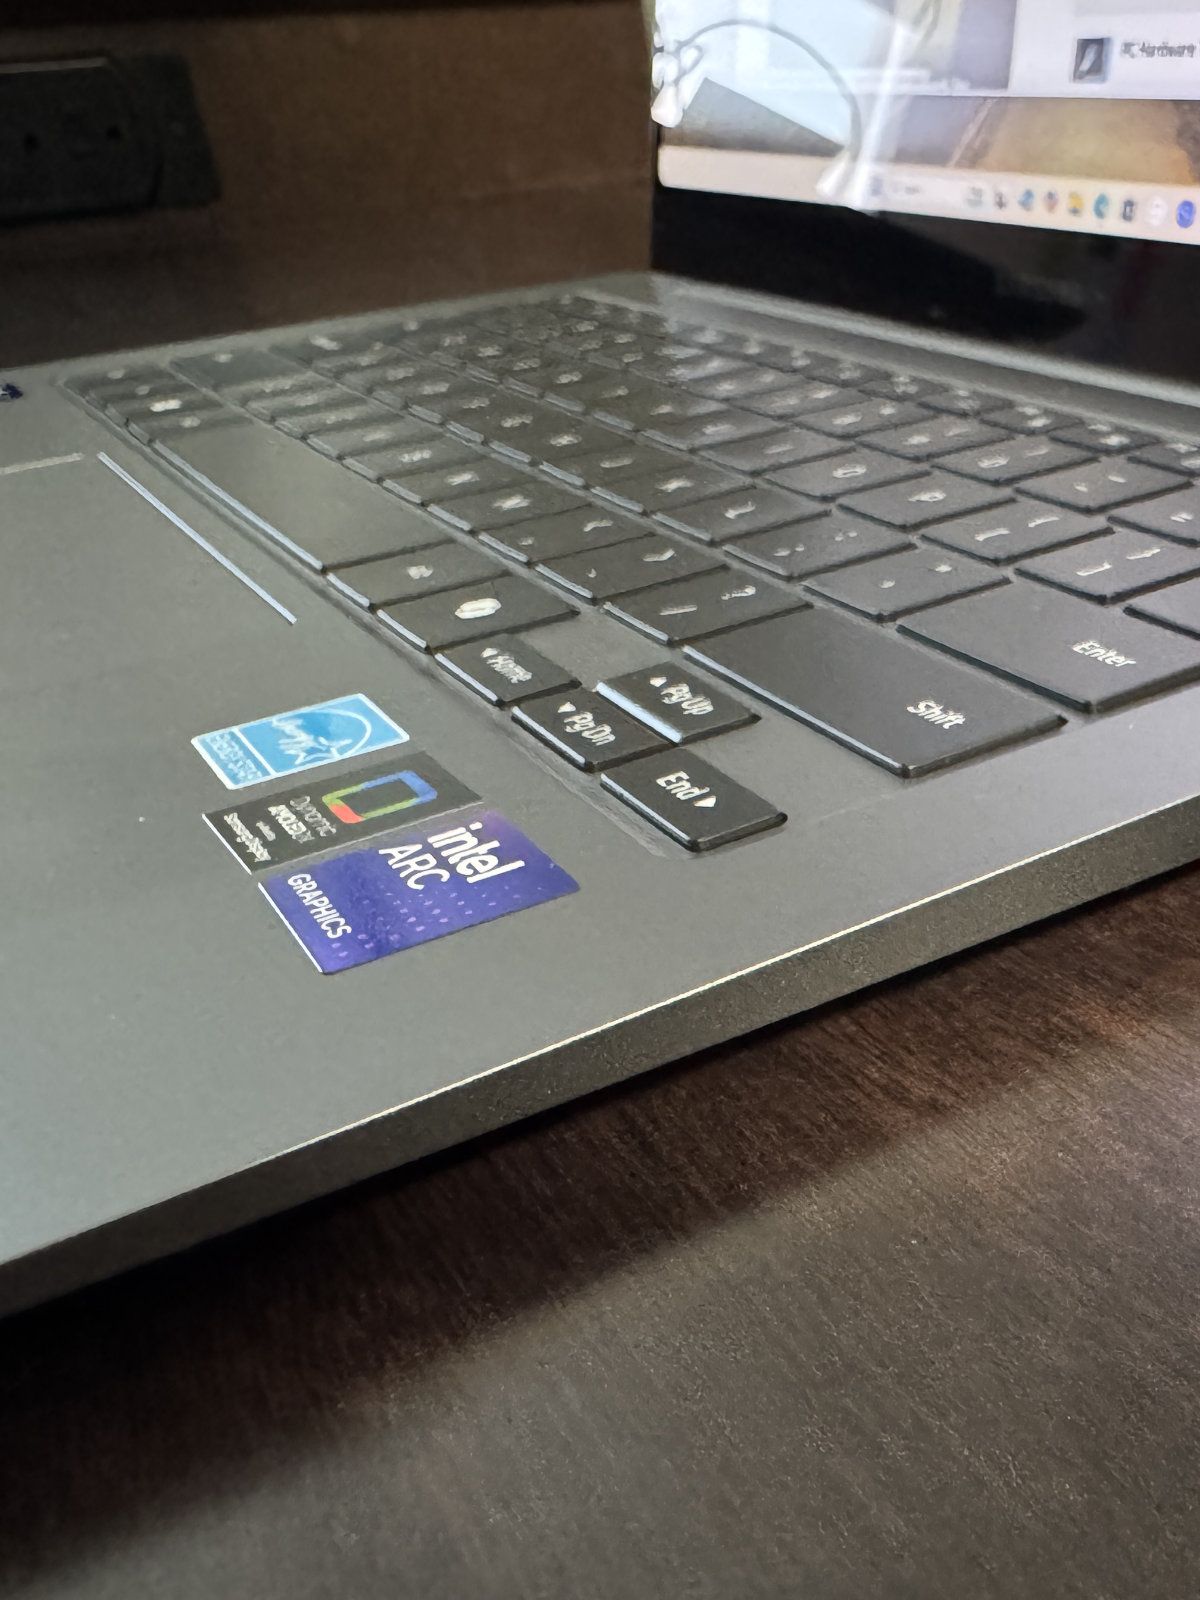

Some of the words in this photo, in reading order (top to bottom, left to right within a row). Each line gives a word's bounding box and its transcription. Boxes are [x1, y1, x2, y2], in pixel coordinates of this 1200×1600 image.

[1072, 639, 1137, 668] Enter
[906, 699, 966, 730] Shift
[655, 769, 711, 801] End
[378, 843, 451, 891] ARC
[427, 821, 526, 884] intel
[286, 872, 352, 940] GRAPHICS
